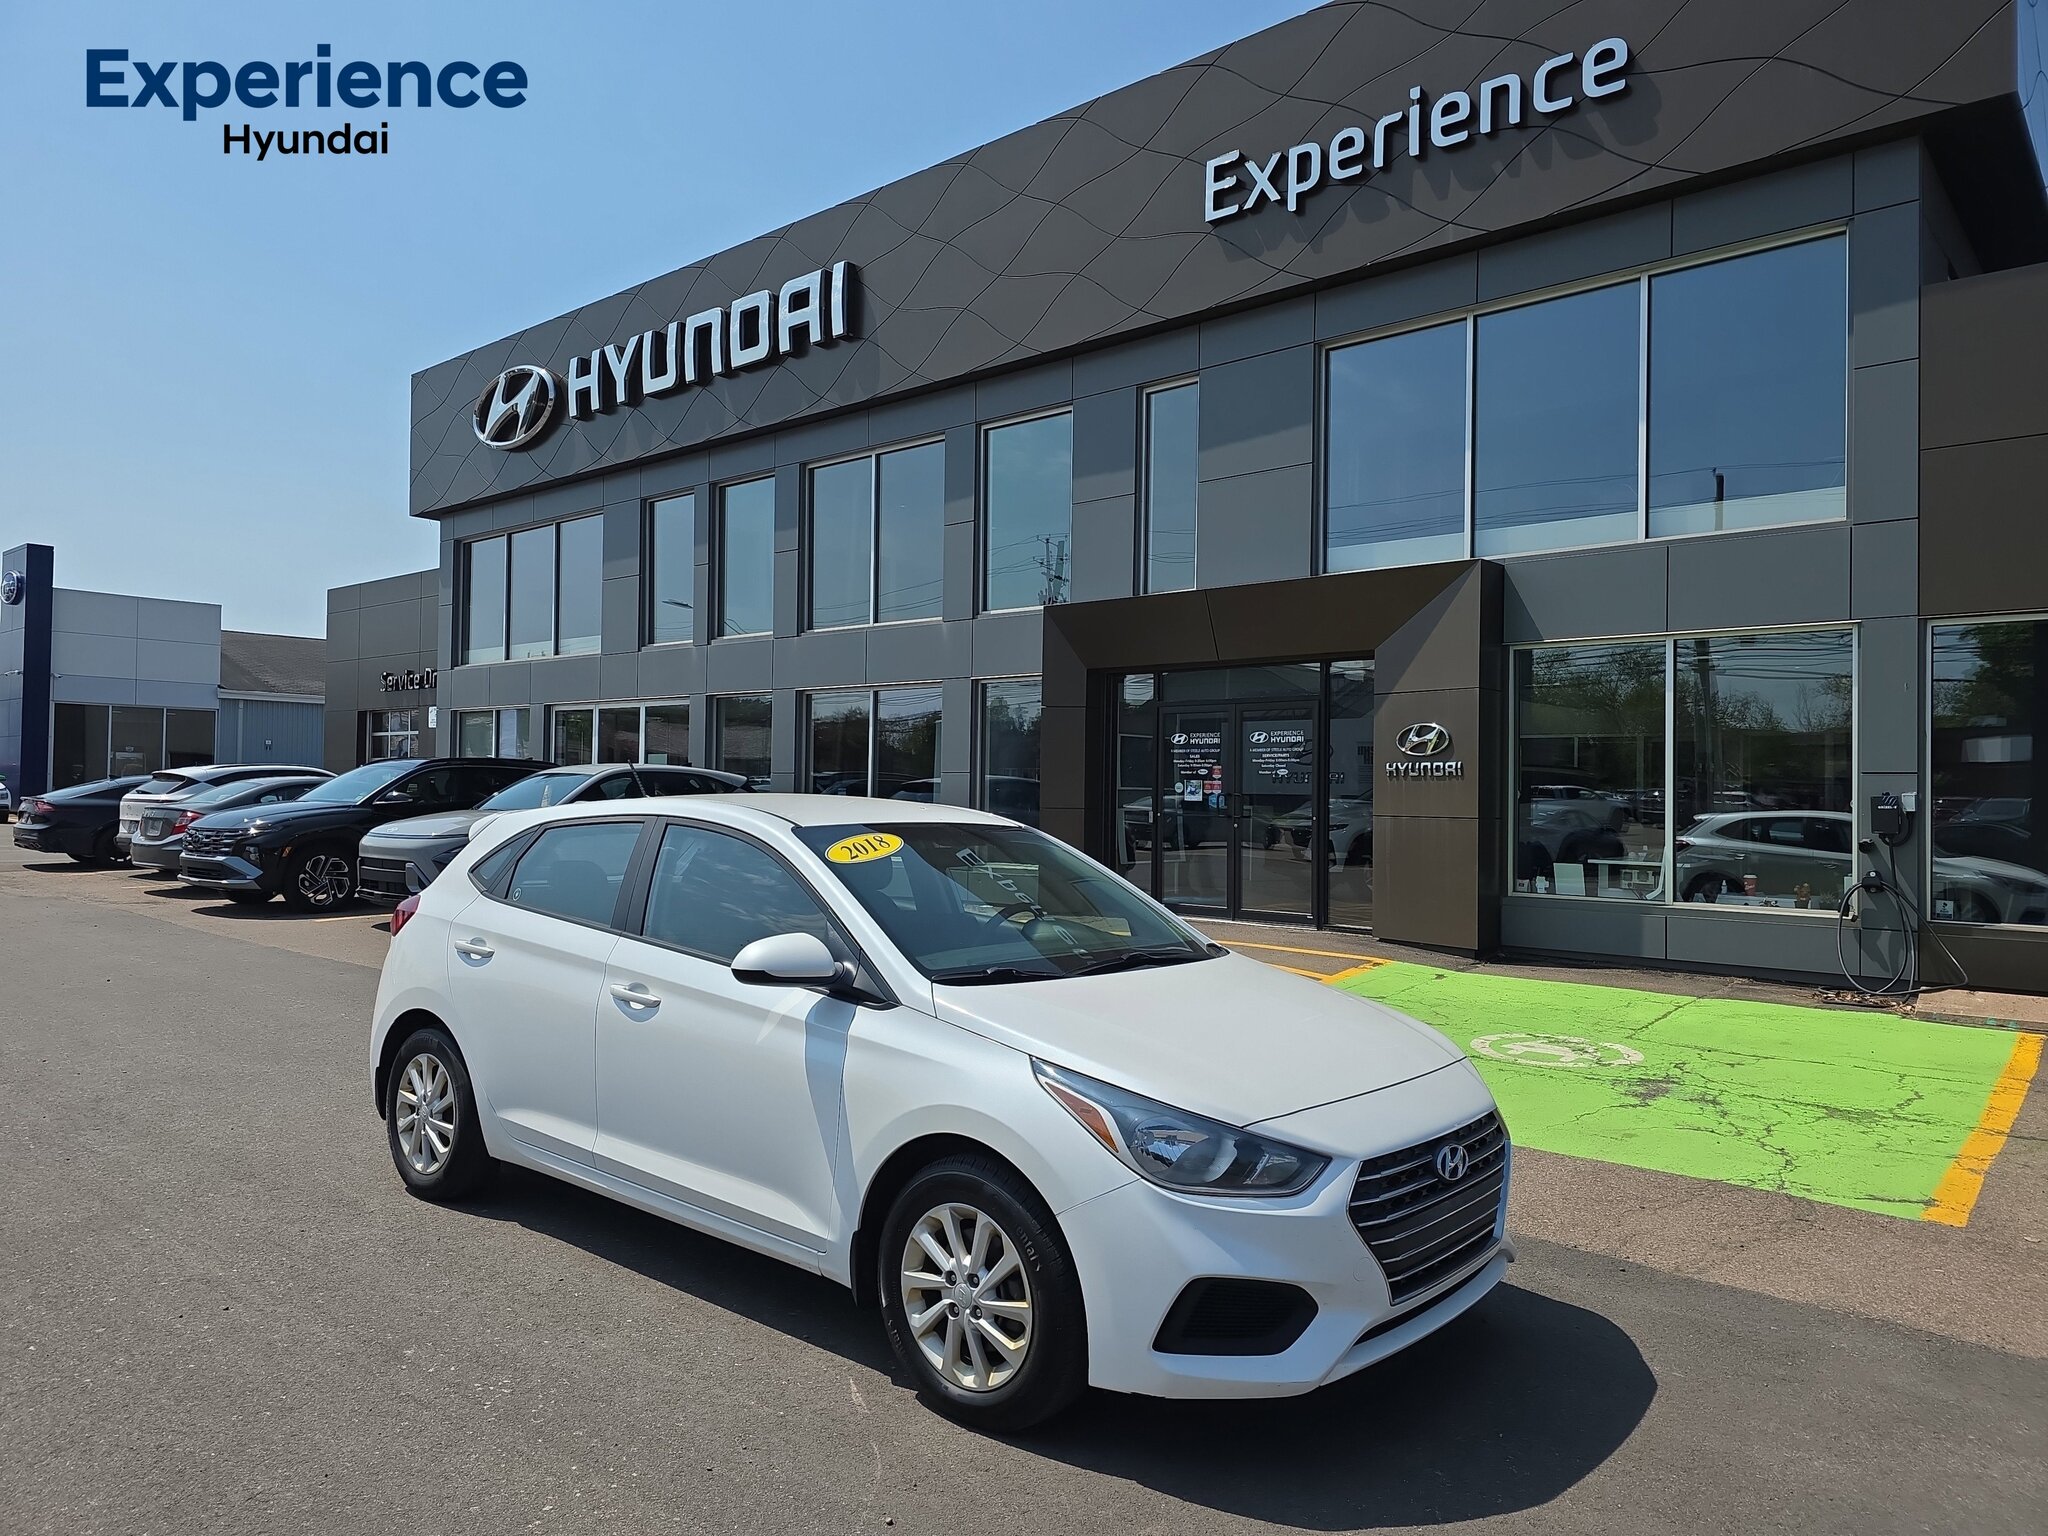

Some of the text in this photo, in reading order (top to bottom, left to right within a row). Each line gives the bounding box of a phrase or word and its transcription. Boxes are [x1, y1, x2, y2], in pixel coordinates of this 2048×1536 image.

[1204, 37, 1629, 223] Experience
[567, 260, 857, 420] HYUNDAI
[380, 669, 420, 692] Service
[1386, 761, 1462, 777] HYUNDAI
[841, 835, 891, 860] 2018
